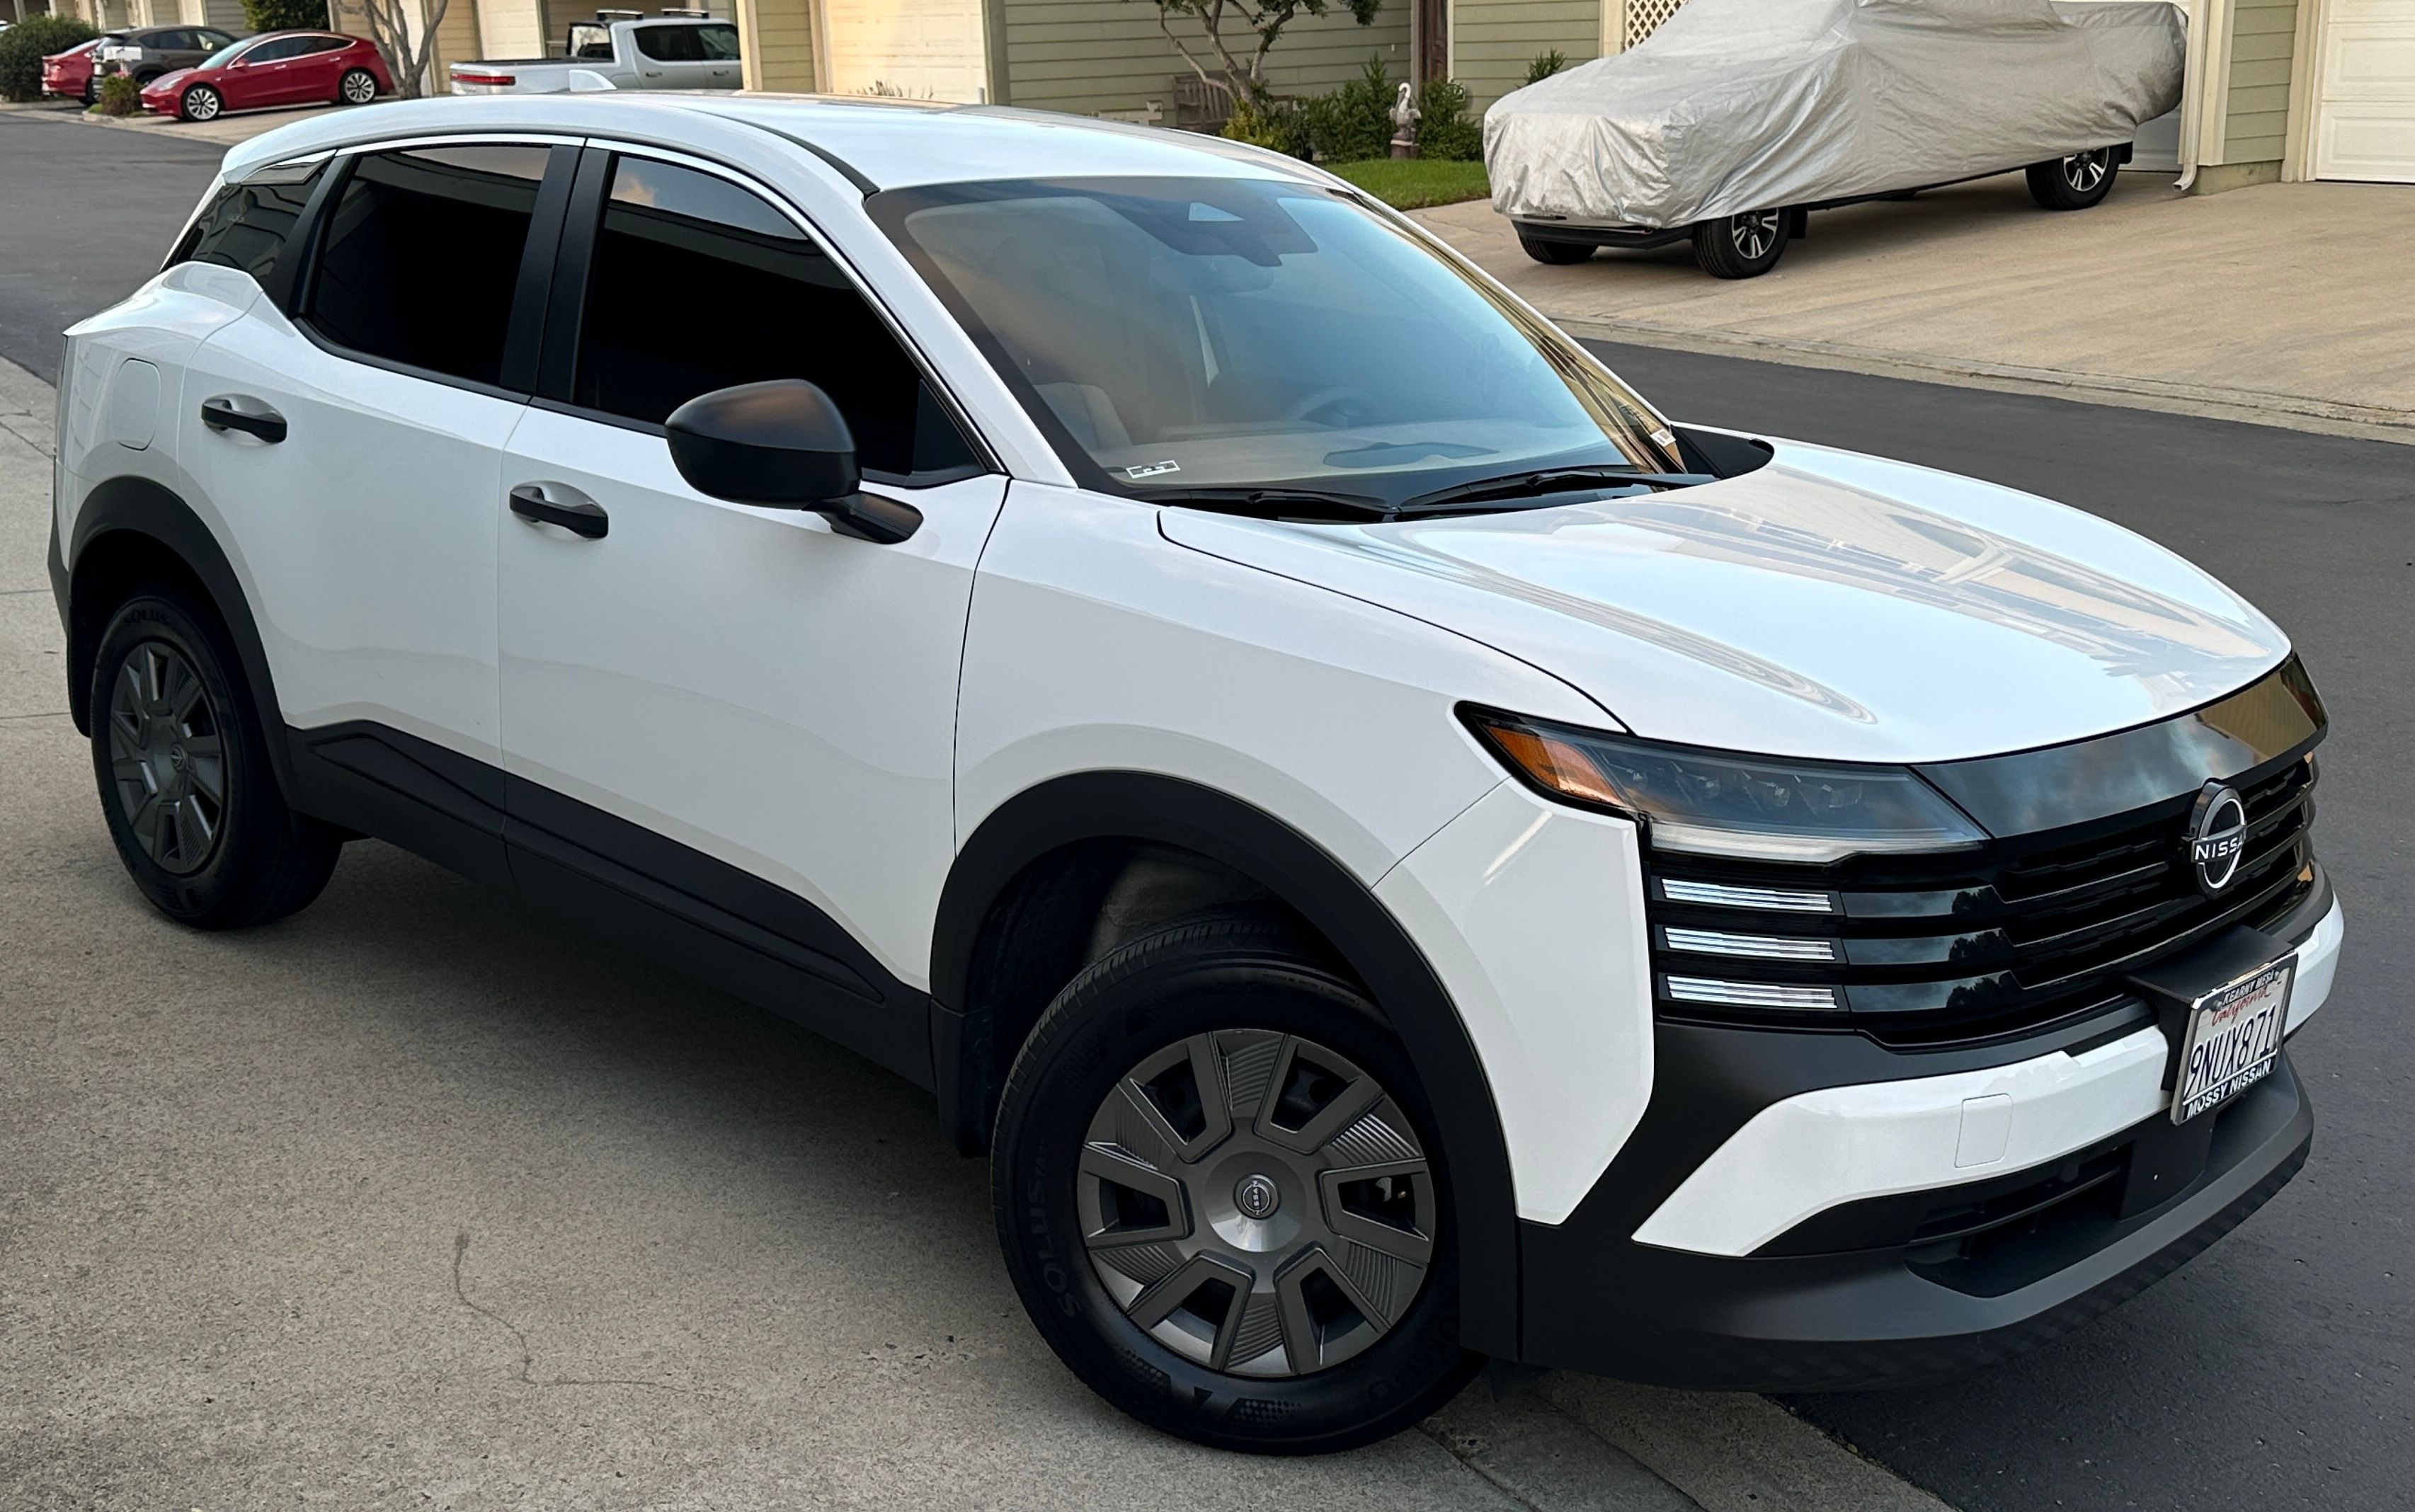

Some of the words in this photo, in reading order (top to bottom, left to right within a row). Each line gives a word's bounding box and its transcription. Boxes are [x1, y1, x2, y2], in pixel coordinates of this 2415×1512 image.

[122, 609, 169, 628] SOLUS
[2212, 985, 2273, 1026] California
[2184, 1002, 2277, 1098] 9NUX871
[2186, 1084, 2228, 1119] MOSSY
[2230, 1058, 2271, 1094] NISSAN
[1251, 1179, 1260, 1215] NISSAN
[1027, 1179, 1083, 1318] SOLUS
